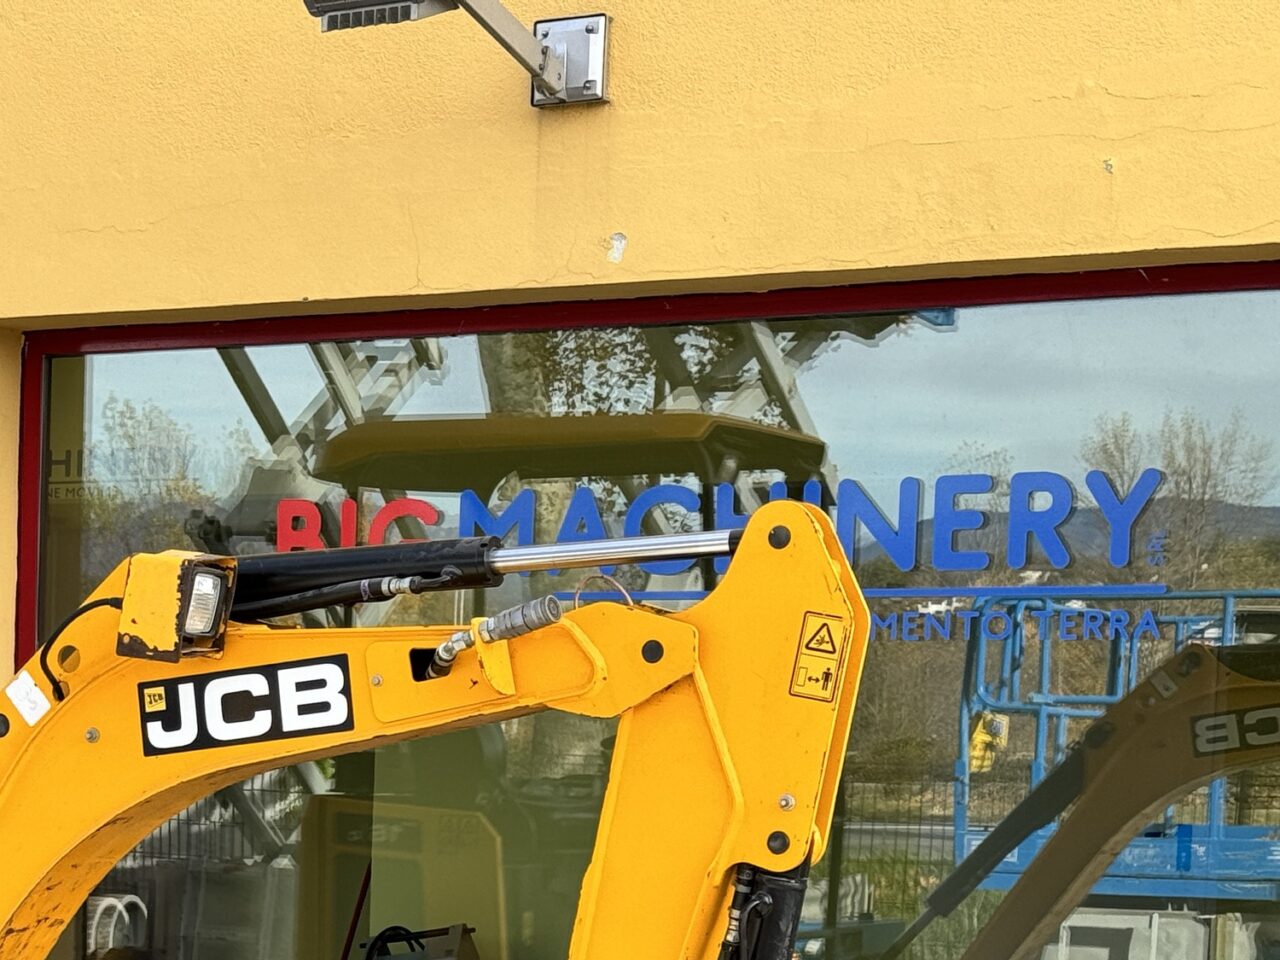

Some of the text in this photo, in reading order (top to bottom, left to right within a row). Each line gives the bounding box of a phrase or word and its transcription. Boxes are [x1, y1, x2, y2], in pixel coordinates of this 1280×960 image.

[459, 468, 1162, 577] MACNERY
[870, 608, 1160, 641] MENTO TERRA
[146, 663, 349, 749] JCB
